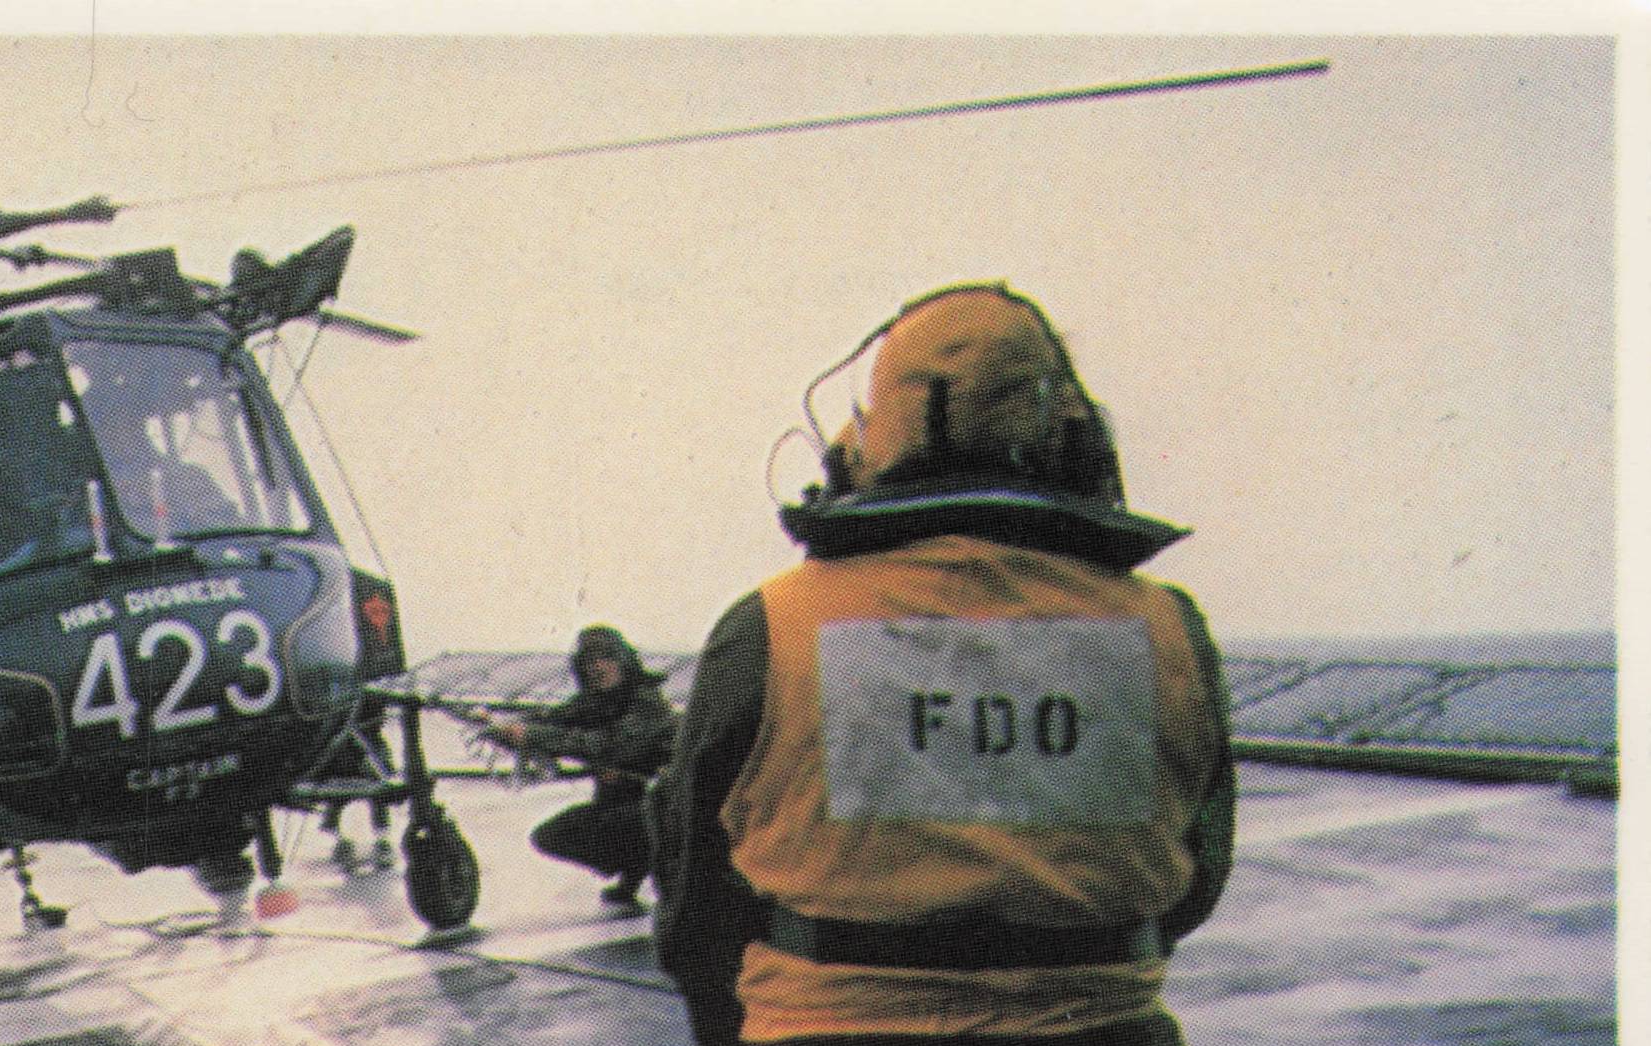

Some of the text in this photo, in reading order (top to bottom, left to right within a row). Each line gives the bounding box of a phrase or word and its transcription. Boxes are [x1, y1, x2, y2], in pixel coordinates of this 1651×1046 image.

[59, 577, 249, 633] HMS DIOMEDE
[71, 607, 282, 739] 423
[910, 690, 1077, 756] FDO
